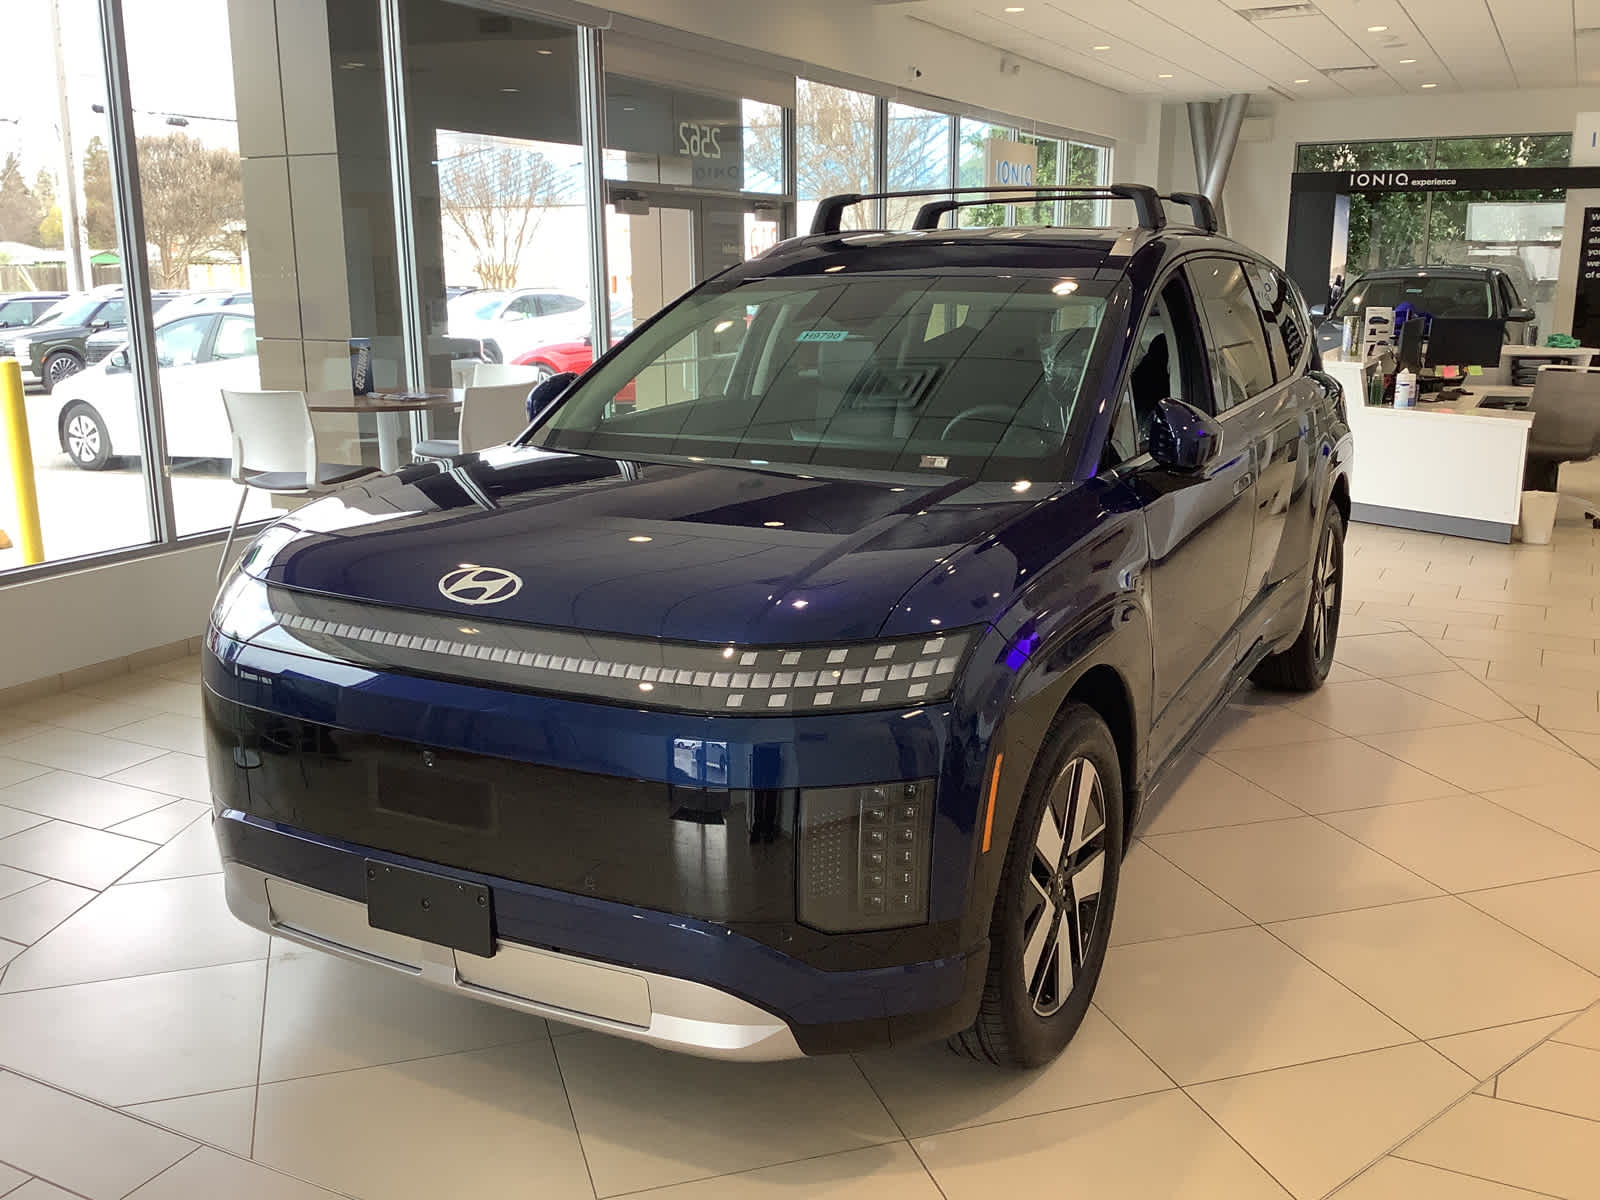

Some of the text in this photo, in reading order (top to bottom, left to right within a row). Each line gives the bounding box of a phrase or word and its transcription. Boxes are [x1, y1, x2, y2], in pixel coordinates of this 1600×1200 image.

[995, 159, 1033, 187] IONIQ
[1350, 173, 1457, 187] IONIQ experience
